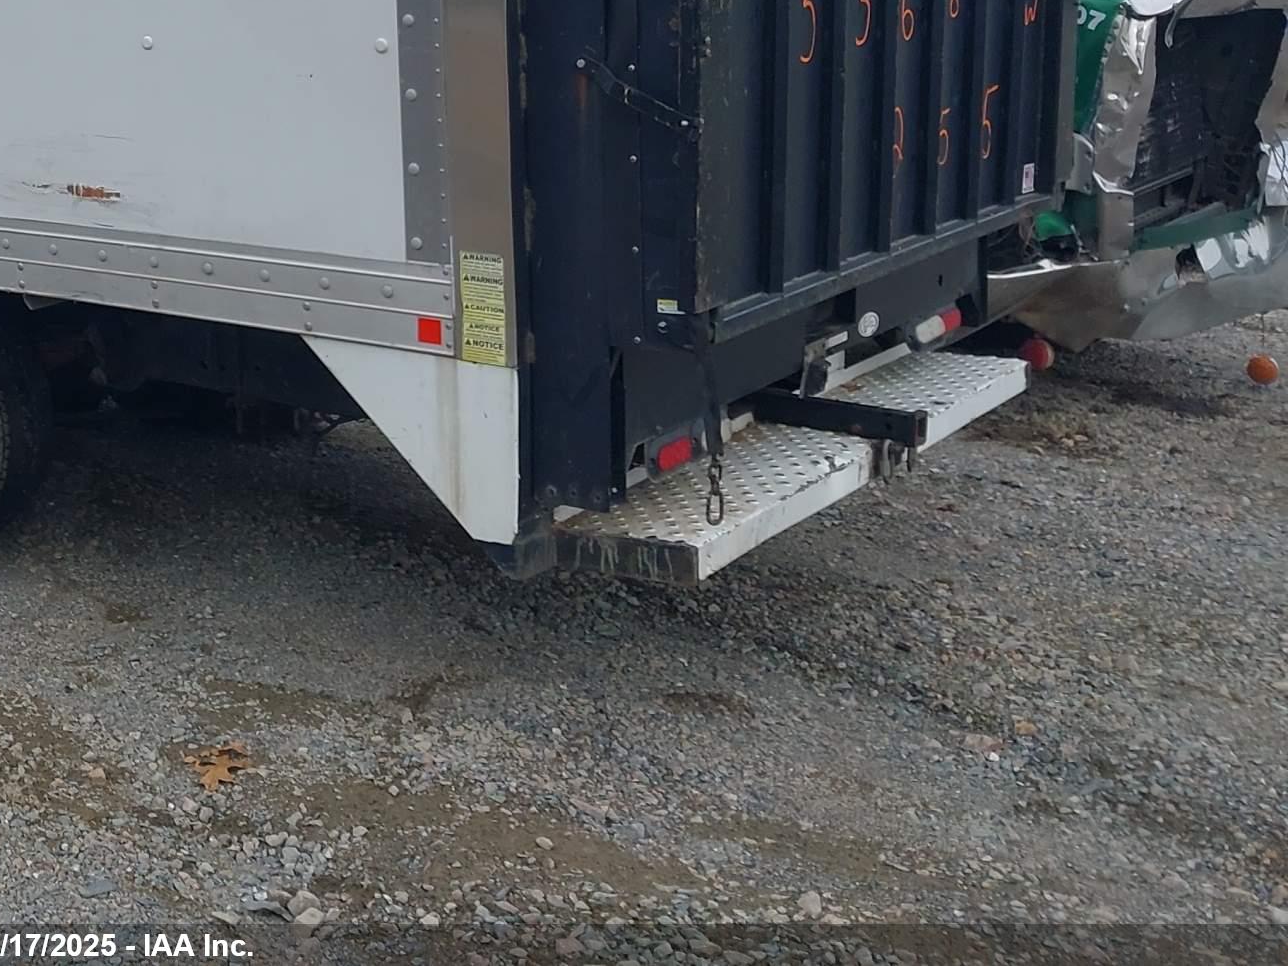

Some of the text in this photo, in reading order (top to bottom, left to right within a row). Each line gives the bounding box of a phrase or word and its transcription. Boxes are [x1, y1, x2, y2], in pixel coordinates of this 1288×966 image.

[469, 254, 502, 264] WARNING
[470, 275, 503, 286] WARNING
[470, 304, 504, 313] CAUTION
[474, 324, 500, 332] NOTICE
[472, 339, 504, 350] NOTICE
